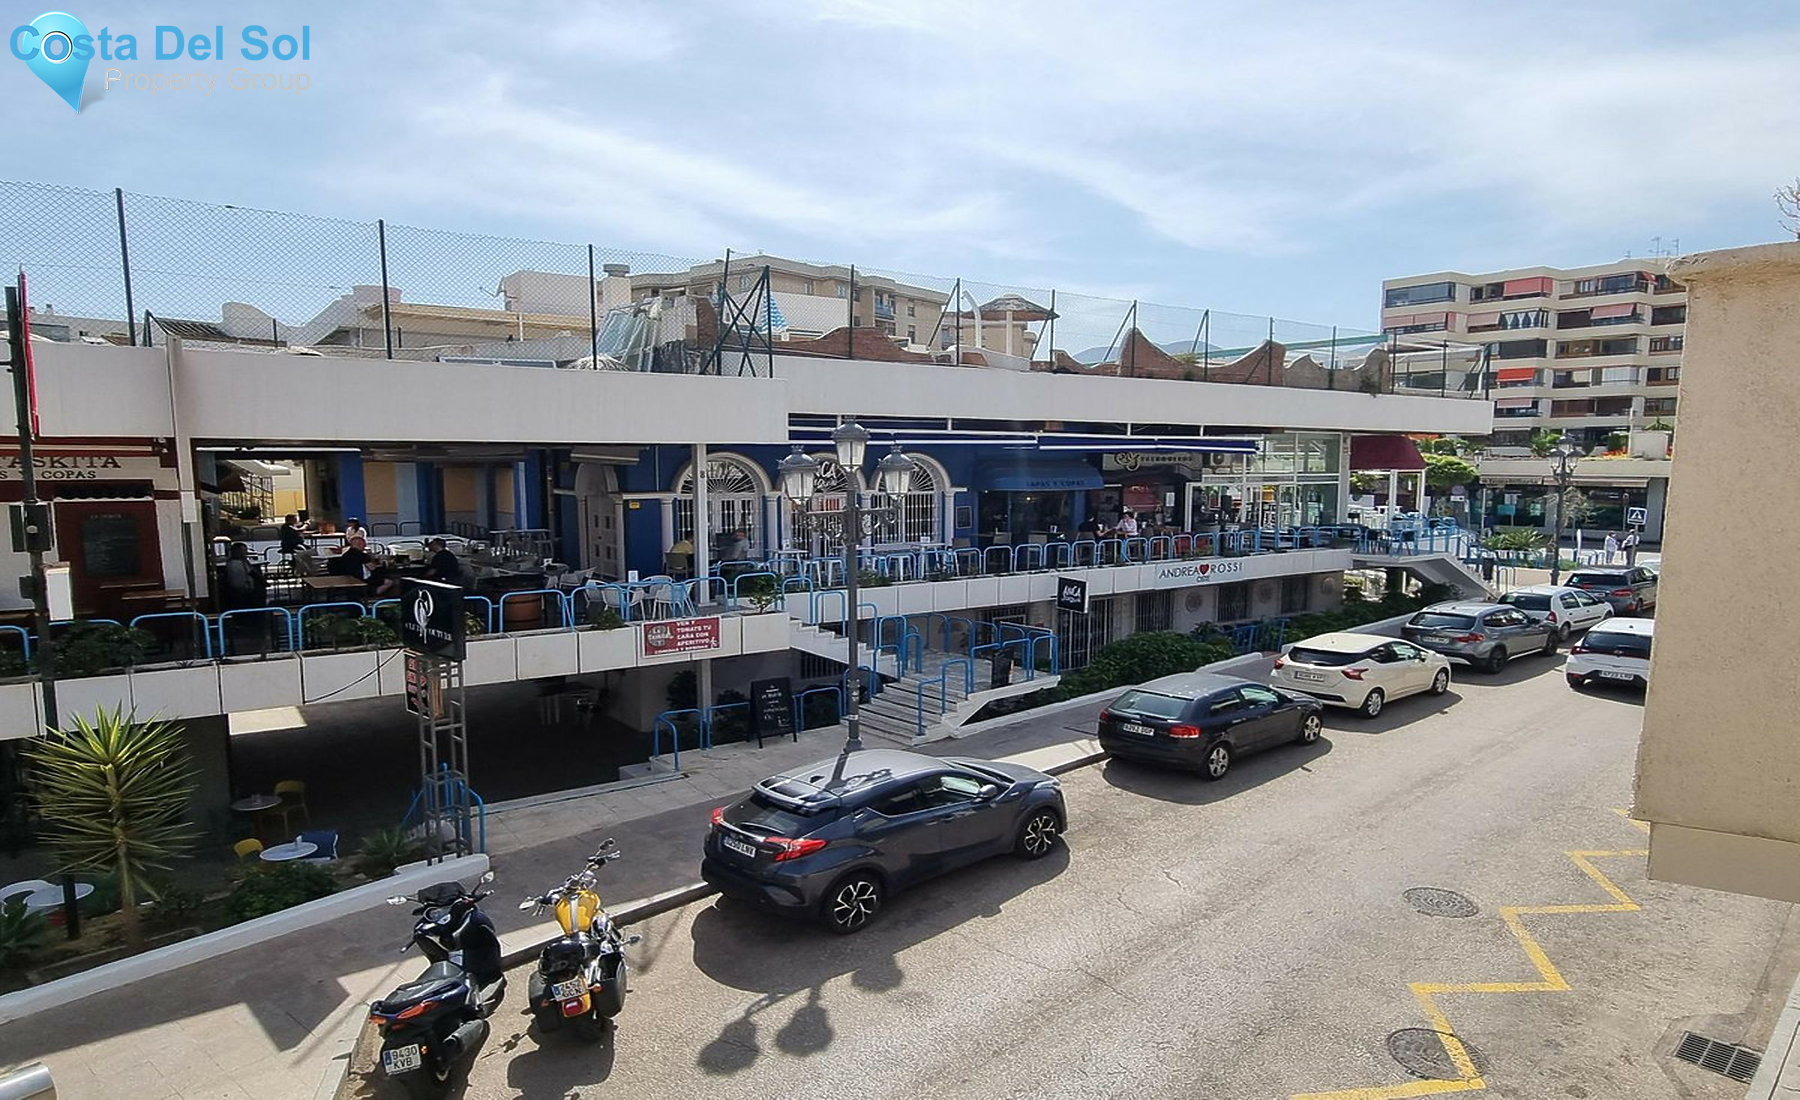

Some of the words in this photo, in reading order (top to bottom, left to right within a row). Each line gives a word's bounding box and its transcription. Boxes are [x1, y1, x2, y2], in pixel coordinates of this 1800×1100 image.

[41, 470, 96, 479] COPAS
[1159, 566, 1200, 579] ANDREA
[1209, 562, 1243, 575] ROSSI
[391, 1046, 418, 1060] 9430
[393, 1057, 414, 1069] KVB
